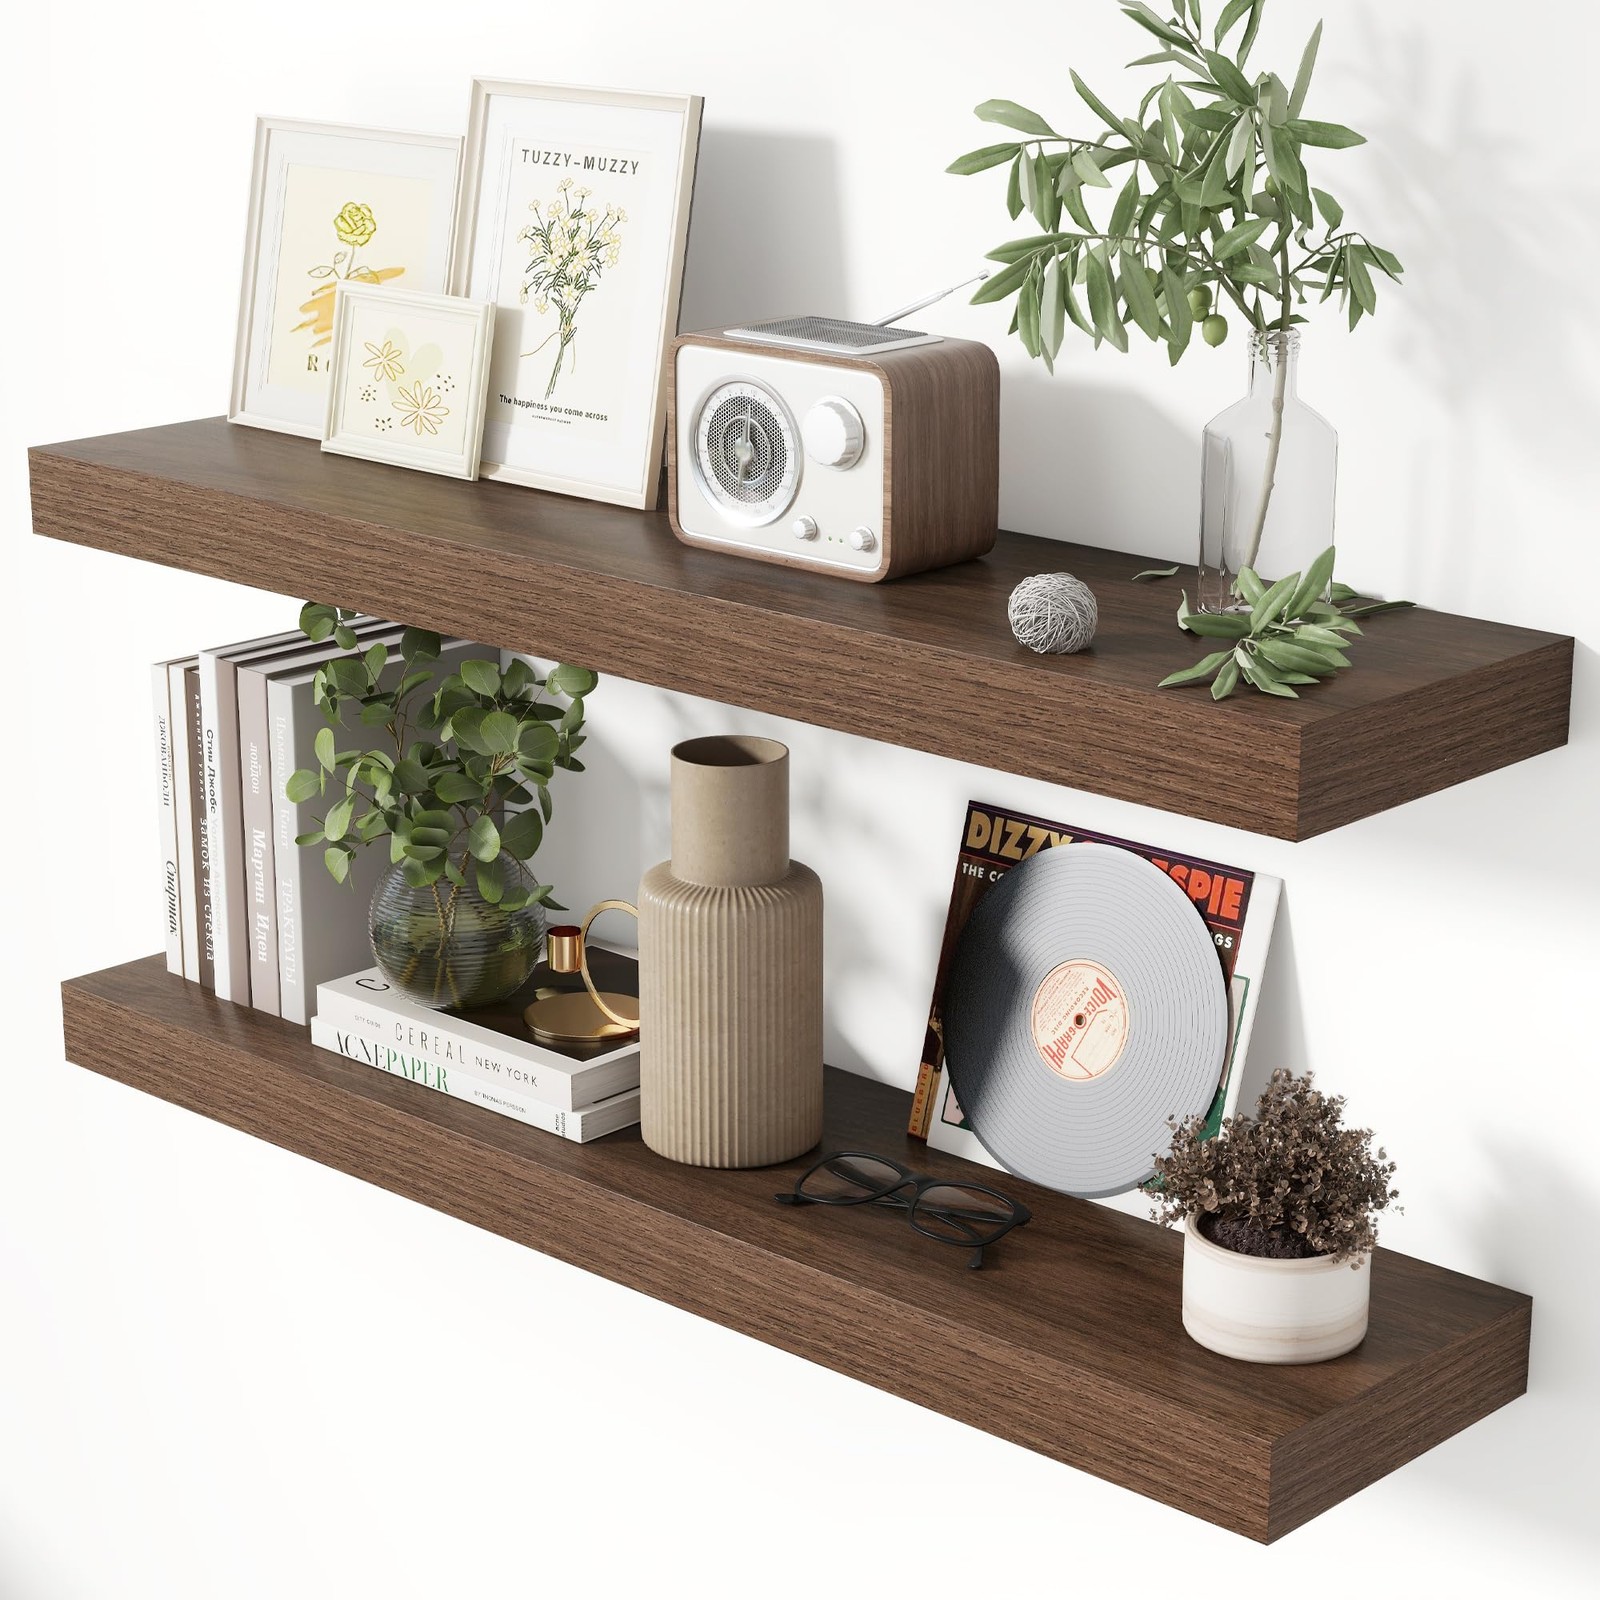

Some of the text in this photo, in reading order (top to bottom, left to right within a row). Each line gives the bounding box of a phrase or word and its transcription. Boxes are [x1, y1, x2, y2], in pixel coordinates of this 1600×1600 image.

[521, 148, 640, 175] TUZZY-MUZZY
[499, 394, 608, 421] The happiness you come across
[207, 765, 218, 814] Джобс
[165, 859, 178, 937] Спартак
[252, 827, 266, 905] Мартин
[256, 912, 270, 963] Иден
[281, 880, 296, 986] ТРАКТАТЫ
[962, 862, 985, 879] THE
[1210, 931, 1233, 949] GS
[395, 1022, 465, 1065] CEREAL
[475, 1056, 501, 1073] NEW
[506, 1067, 538, 1088] YORK
